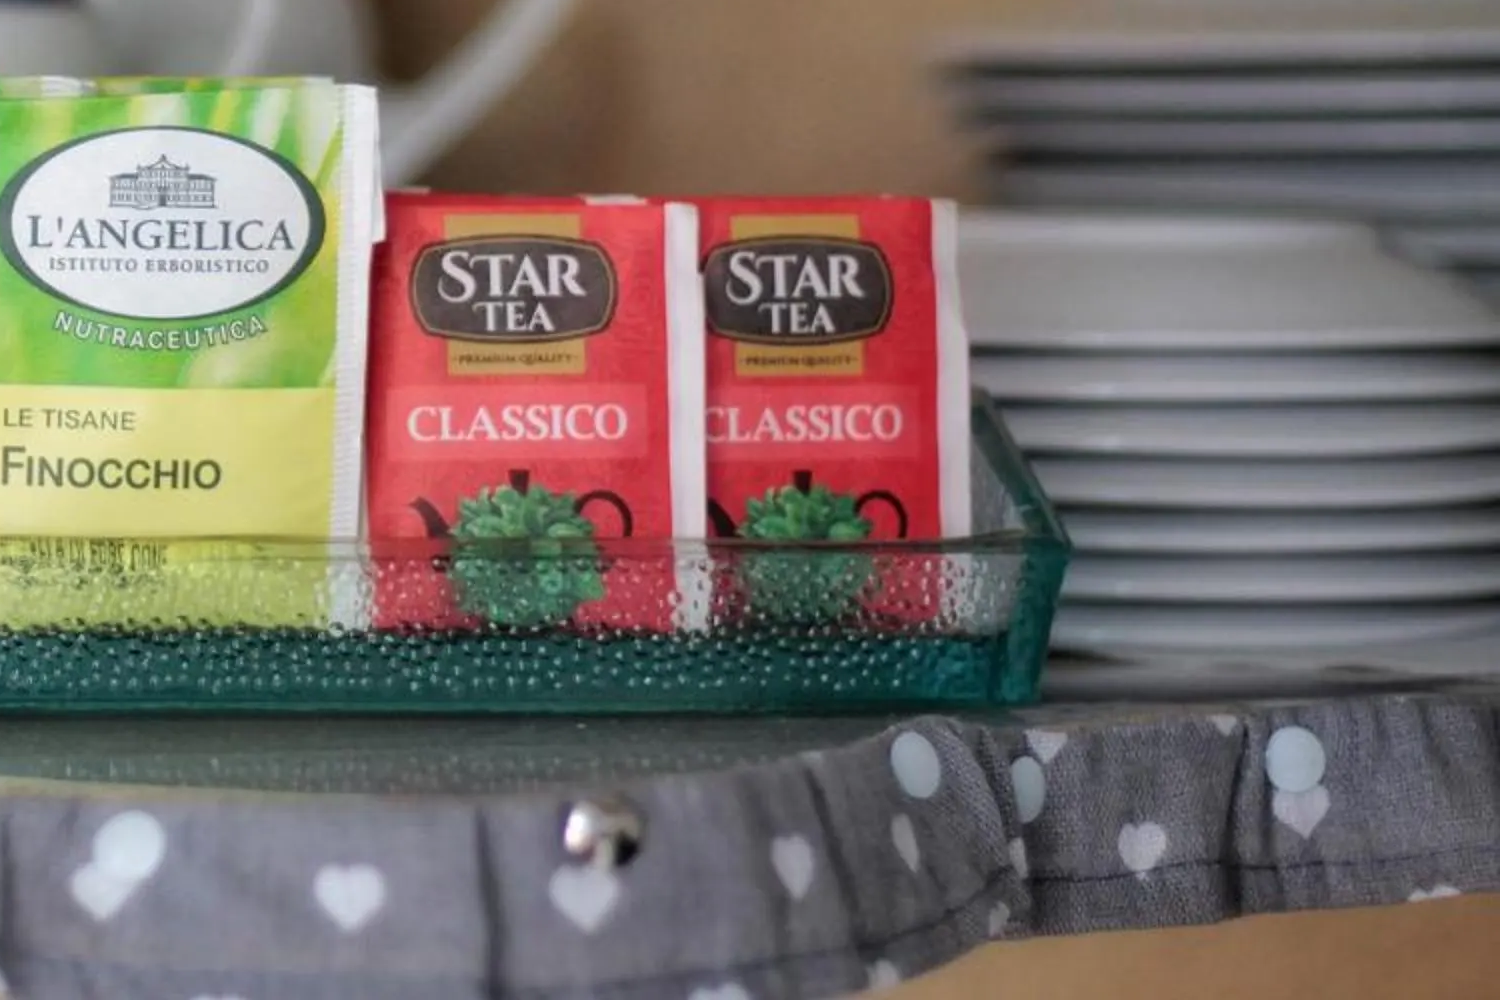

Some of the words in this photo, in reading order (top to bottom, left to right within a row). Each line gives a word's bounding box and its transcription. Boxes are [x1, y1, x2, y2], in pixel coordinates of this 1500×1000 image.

[26, 214, 296, 252] L'ANGELICA
[48, 256, 138, 273] ISTITUTO
[145, 258, 270, 274] ERBORISTICO
[437, 250, 588, 304] STAR
[725, 250, 866, 305] STAR
[53, 310, 268, 351] NUTRACEUTICA
[471, 301, 556, 333] TEA
[757, 302, 837, 334] TEA
[2, 407, 34, 428] LE
[42, 408, 137, 431] TISANE
[406, 402, 629, 443] CLASSICO
[705, 403, 903, 443] CLASSICO
[0, 445, 222, 490] FINOCCHIO
